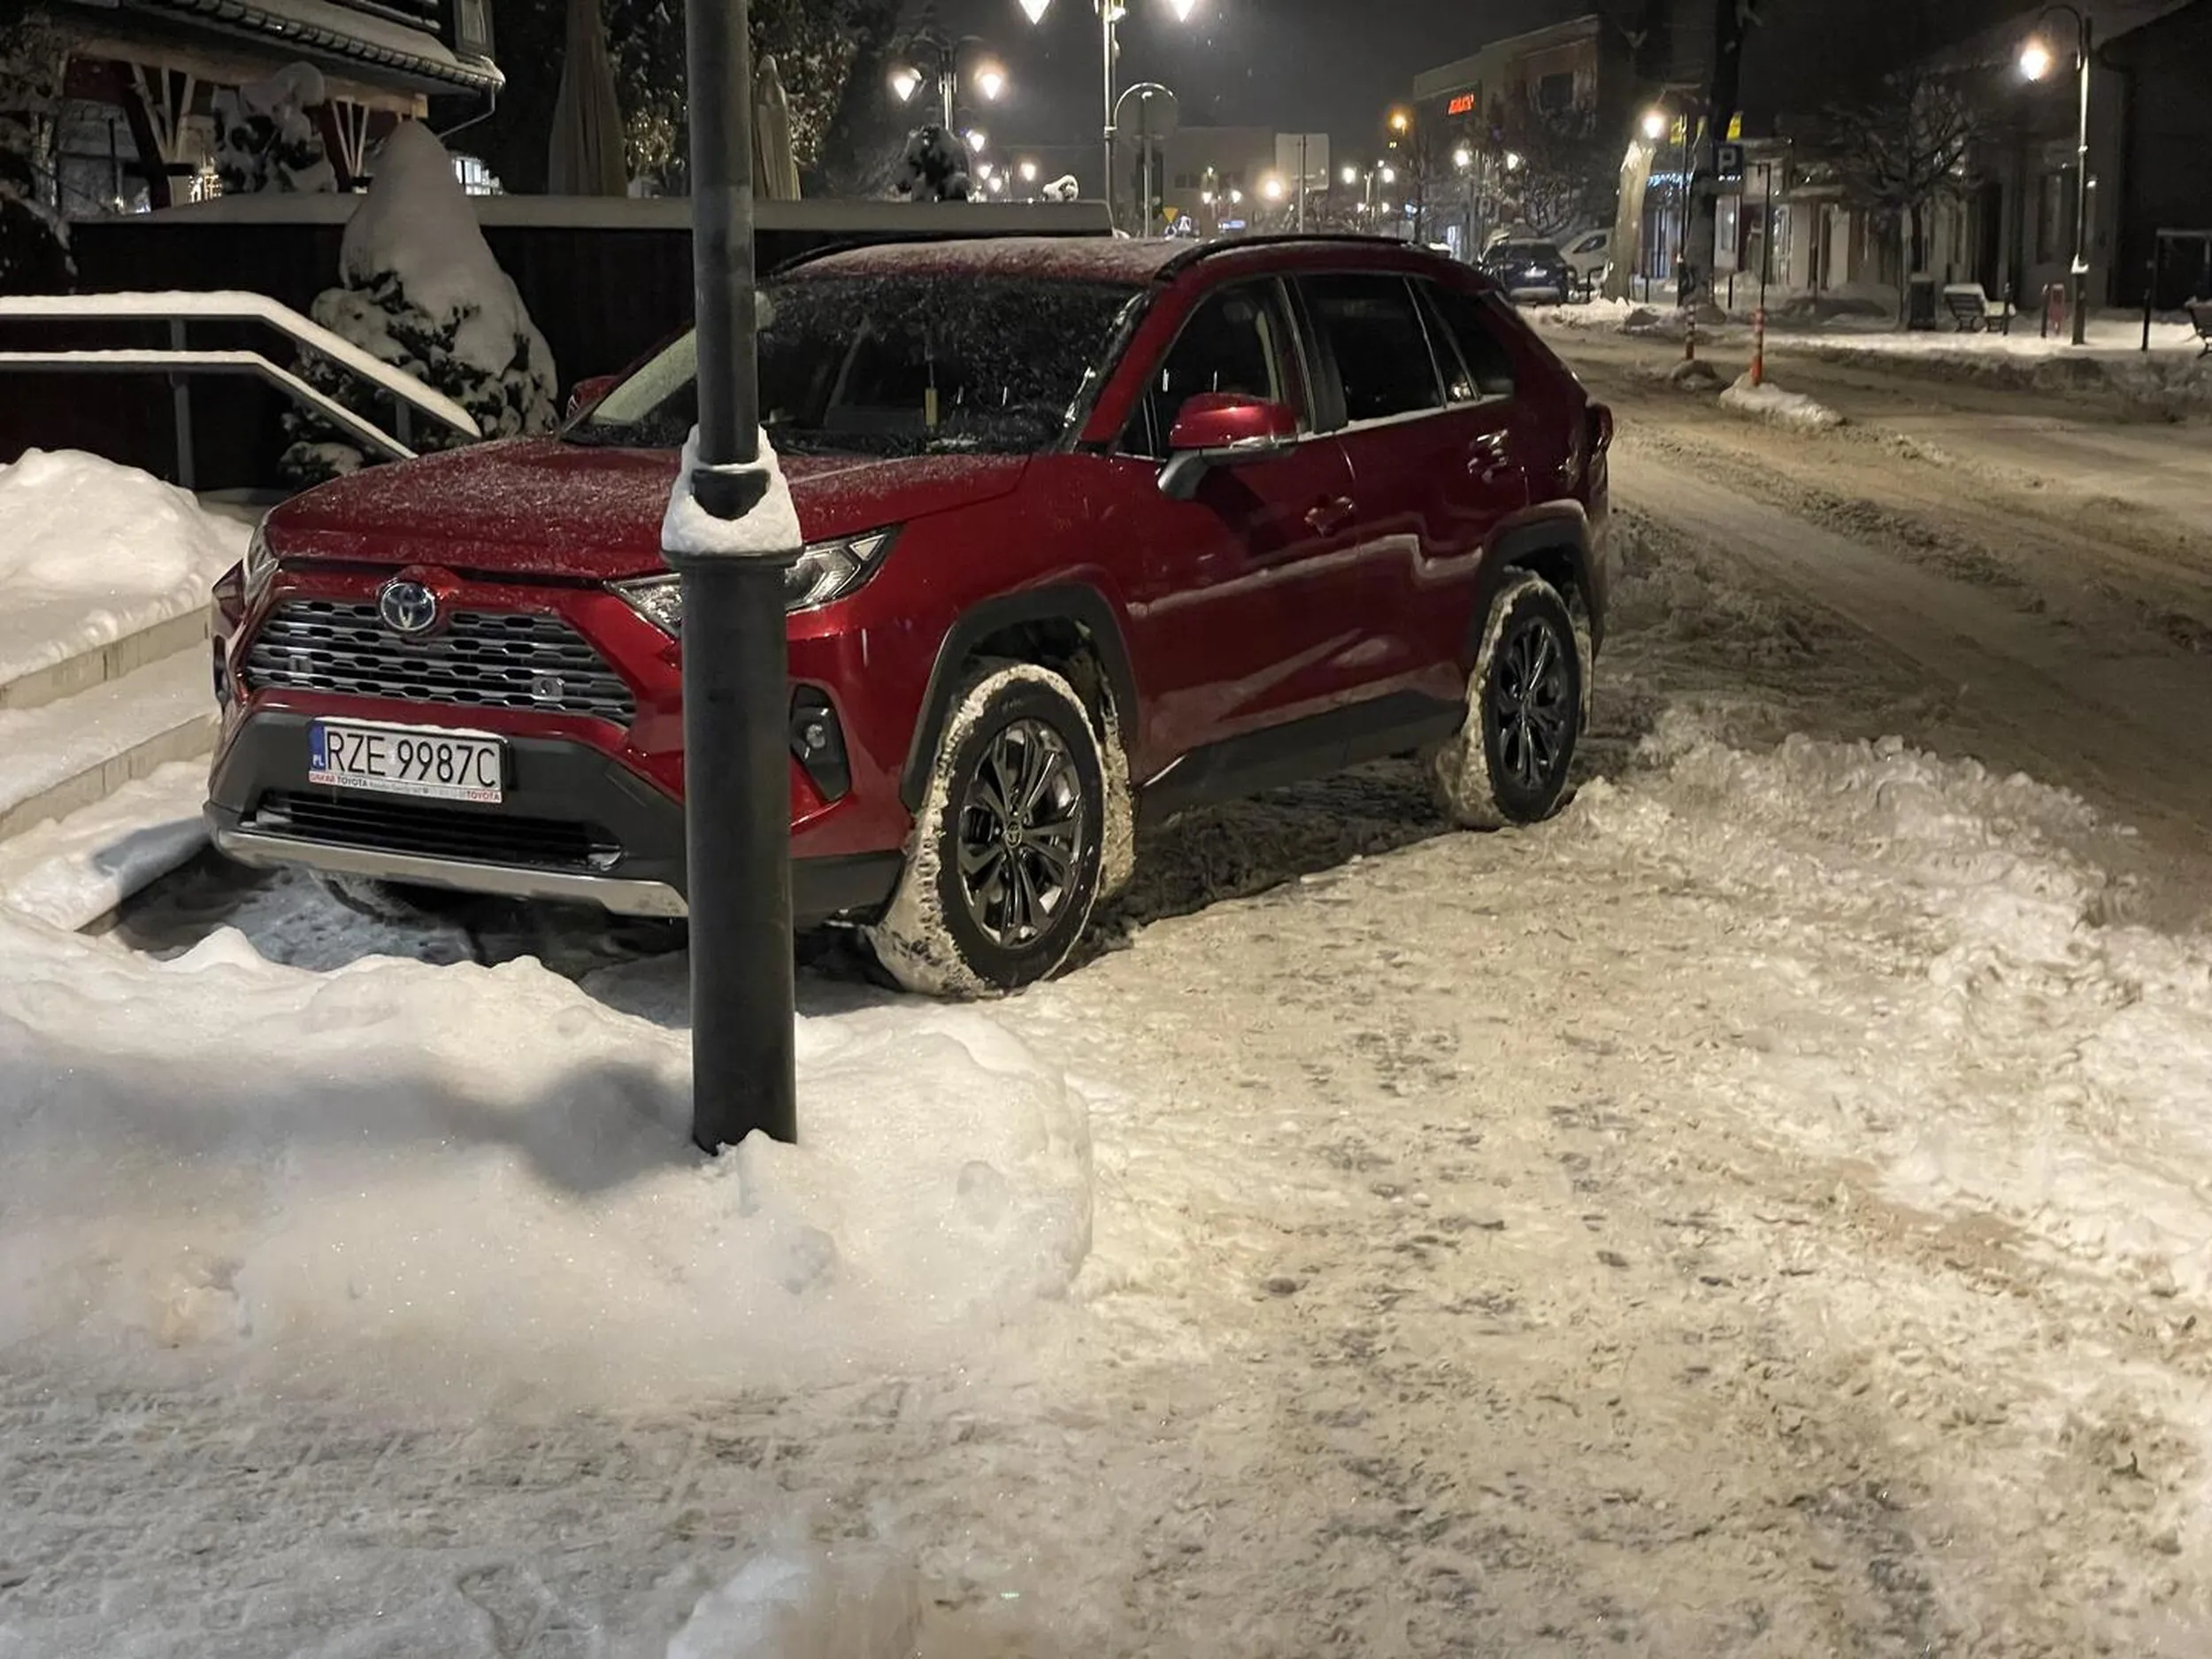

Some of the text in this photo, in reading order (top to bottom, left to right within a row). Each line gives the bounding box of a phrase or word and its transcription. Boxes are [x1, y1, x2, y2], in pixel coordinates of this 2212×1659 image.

[1718, 148, 1736, 173] P
[312, 754, 325, 766] PL
[327, 732, 495, 787] RZE 9987C
[337, 775, 367, 787] TOYOTA
[466, 790, 500, 801] TOYOTA
